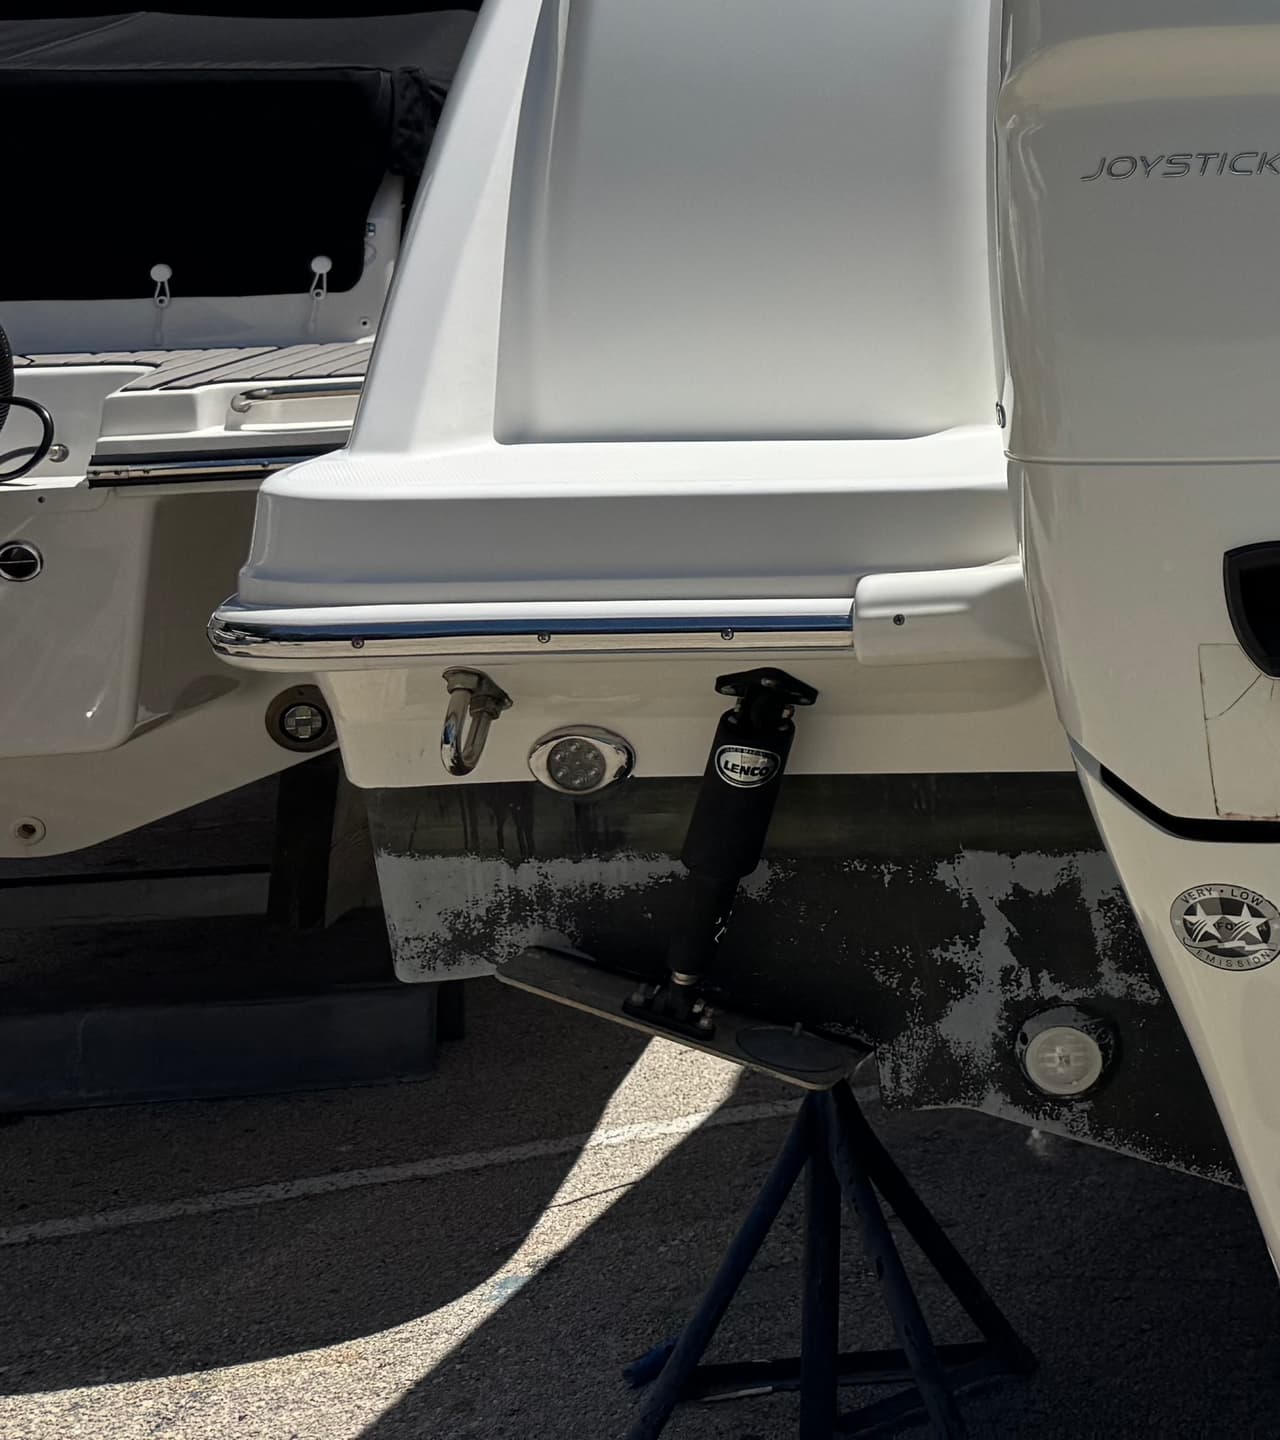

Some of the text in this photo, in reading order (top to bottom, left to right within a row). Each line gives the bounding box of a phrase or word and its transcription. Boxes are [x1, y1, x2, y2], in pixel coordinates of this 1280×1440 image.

[723, 760, 770, 777] LENCO
[1180, 886, 1264, 907] VERY LOW
[1195, 948, 1271, 968] EMISSION
